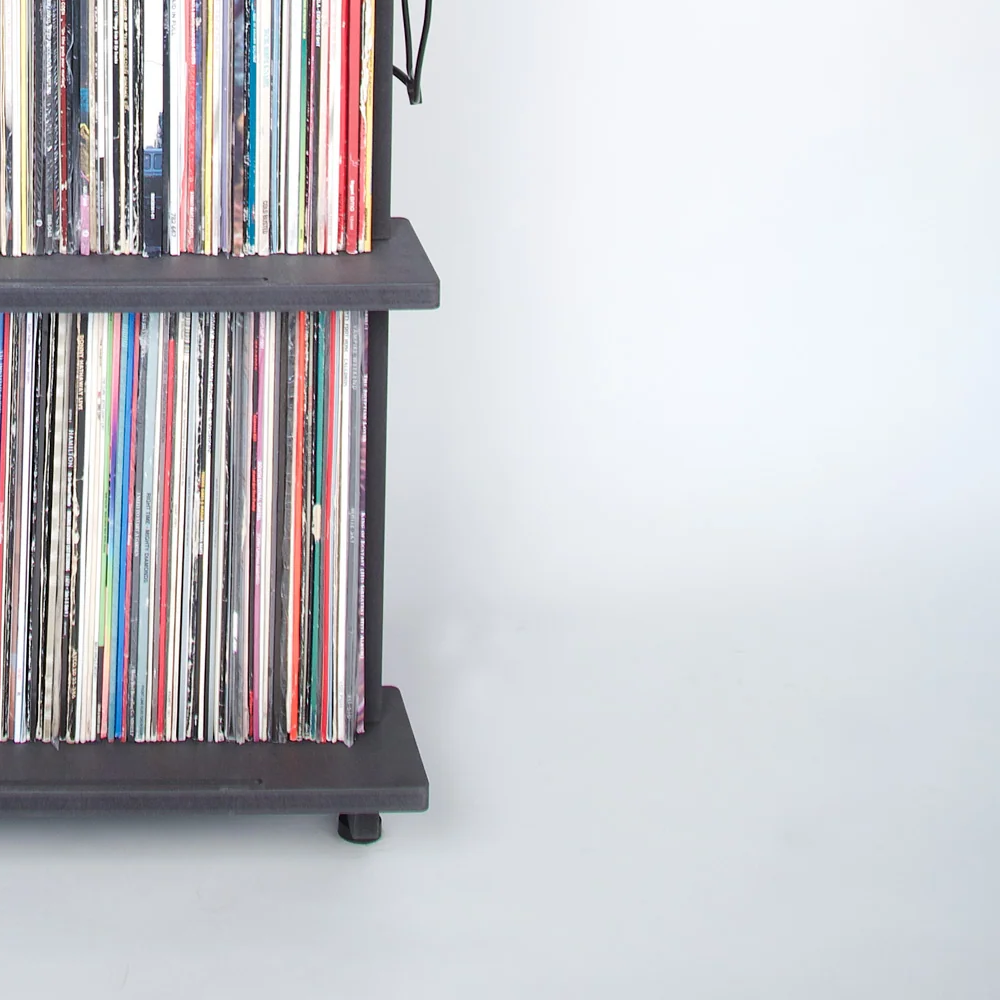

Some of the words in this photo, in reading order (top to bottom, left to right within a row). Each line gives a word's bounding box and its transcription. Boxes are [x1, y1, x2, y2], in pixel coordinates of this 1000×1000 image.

[171, 11, 177, 19] IN
[351, 324, 359, 355] VAMPIRE
[67, 429, 75, 468] HAMILTON
[360, 529, 366, 539] OF
